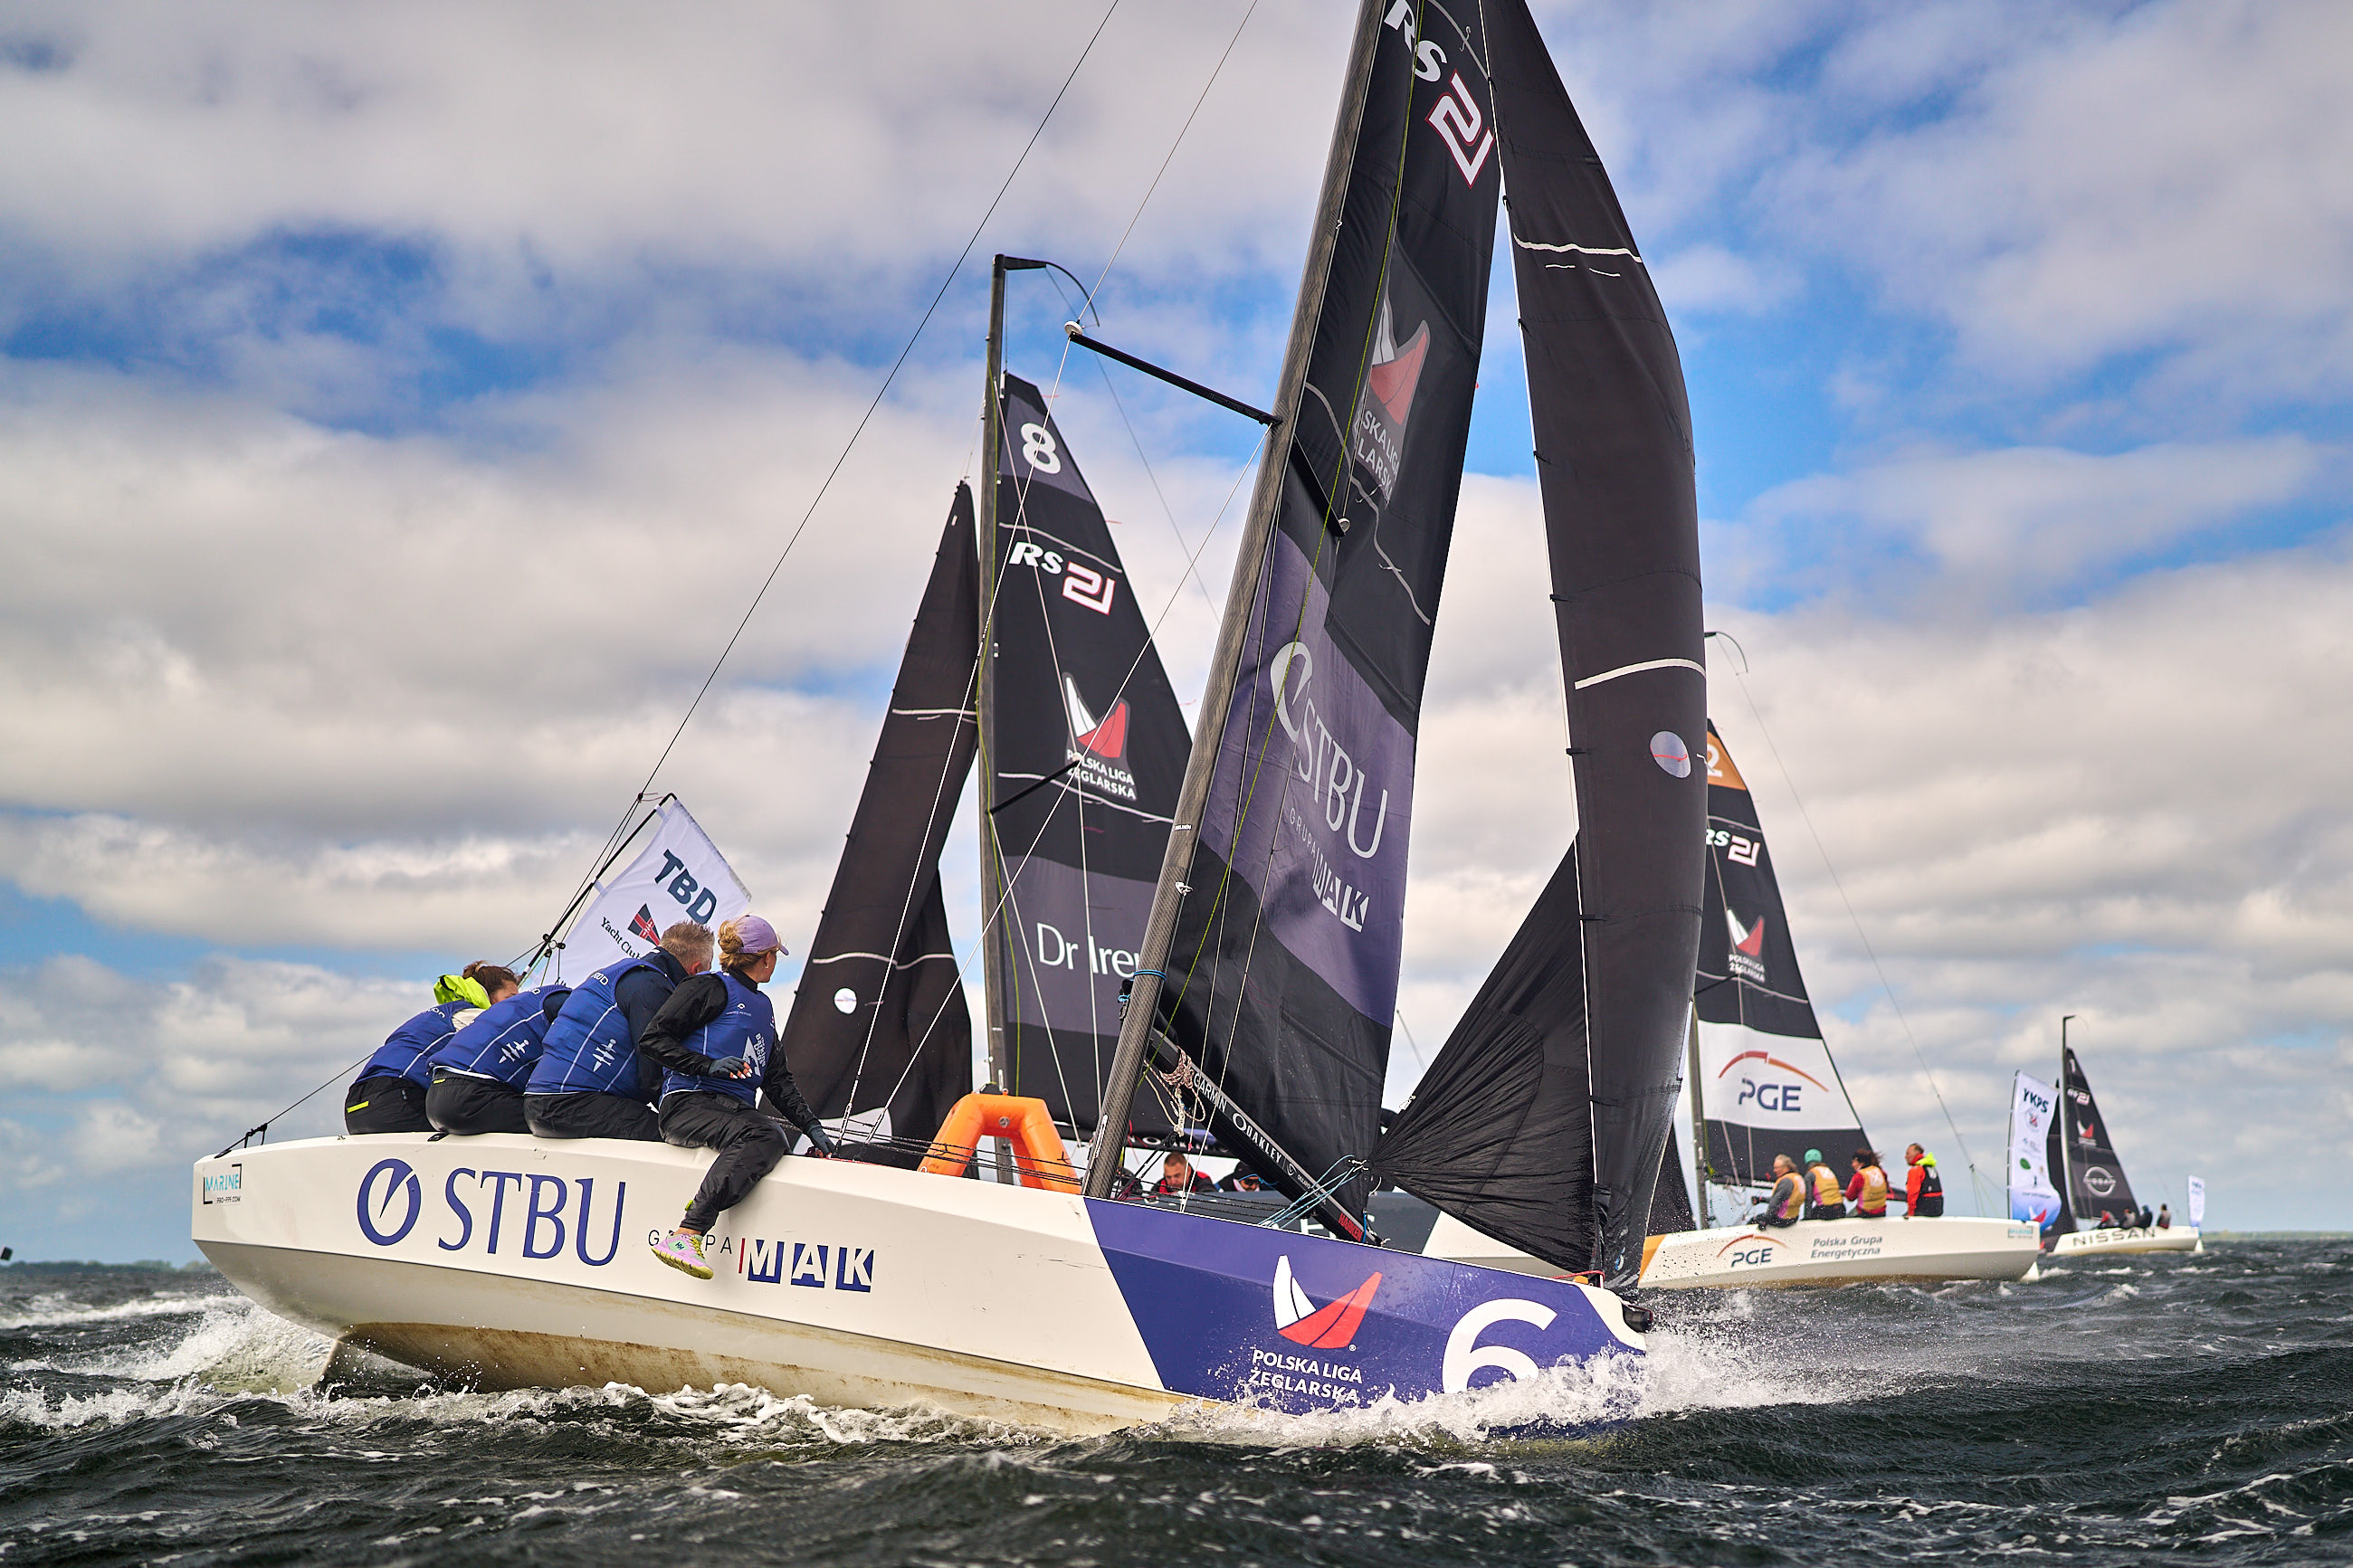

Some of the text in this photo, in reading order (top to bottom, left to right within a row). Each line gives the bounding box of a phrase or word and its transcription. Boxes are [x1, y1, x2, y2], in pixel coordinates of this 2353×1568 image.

[1383, 0, 1495, 189] RS 21
[1020, 422, 1062, 474] 8
[1009, 541, 1116, 615] RS 21
[1067, 748, 1136, 786] PLSKA LIGA
[1298, 698, 1393, 859] STBU
[1706, 743, 1723, 778] 2
[1290, 807, 1369, 933] GRUPA MAK
[1727, 835, 1760, 867] 21
[654, 849, 717, 925] TBD
[601, 917, 624, 945] Yacht
[1036, 922, 1079, 970] Dr
[1194, 1073, 1227, 1112] GARMN
[1739, 1078, 1802, 1111] PGE
[1246, 1125, 1282, 1164] OAKLEY
[205, 1174, 239, 1192] MARINE
[438, 1167, 626, 1267] STBU
[1731, 1247, 1773, 1267] PGE
[1811, 1248, 1881, 1259] Energetyczna
[1813, 1236, 1882, 1248] Polska Grupa
[2072, 1229, 2156, 1247] NISSAN
[648, 1229, 874, 1293] GPA MAK
[1443, 1298, 1558, 1394] 6
[1248, 1366, 1361, 1404] ŻEGLARSKA
[1253, 1349, 1363, 1383] POLSKA LIGA
